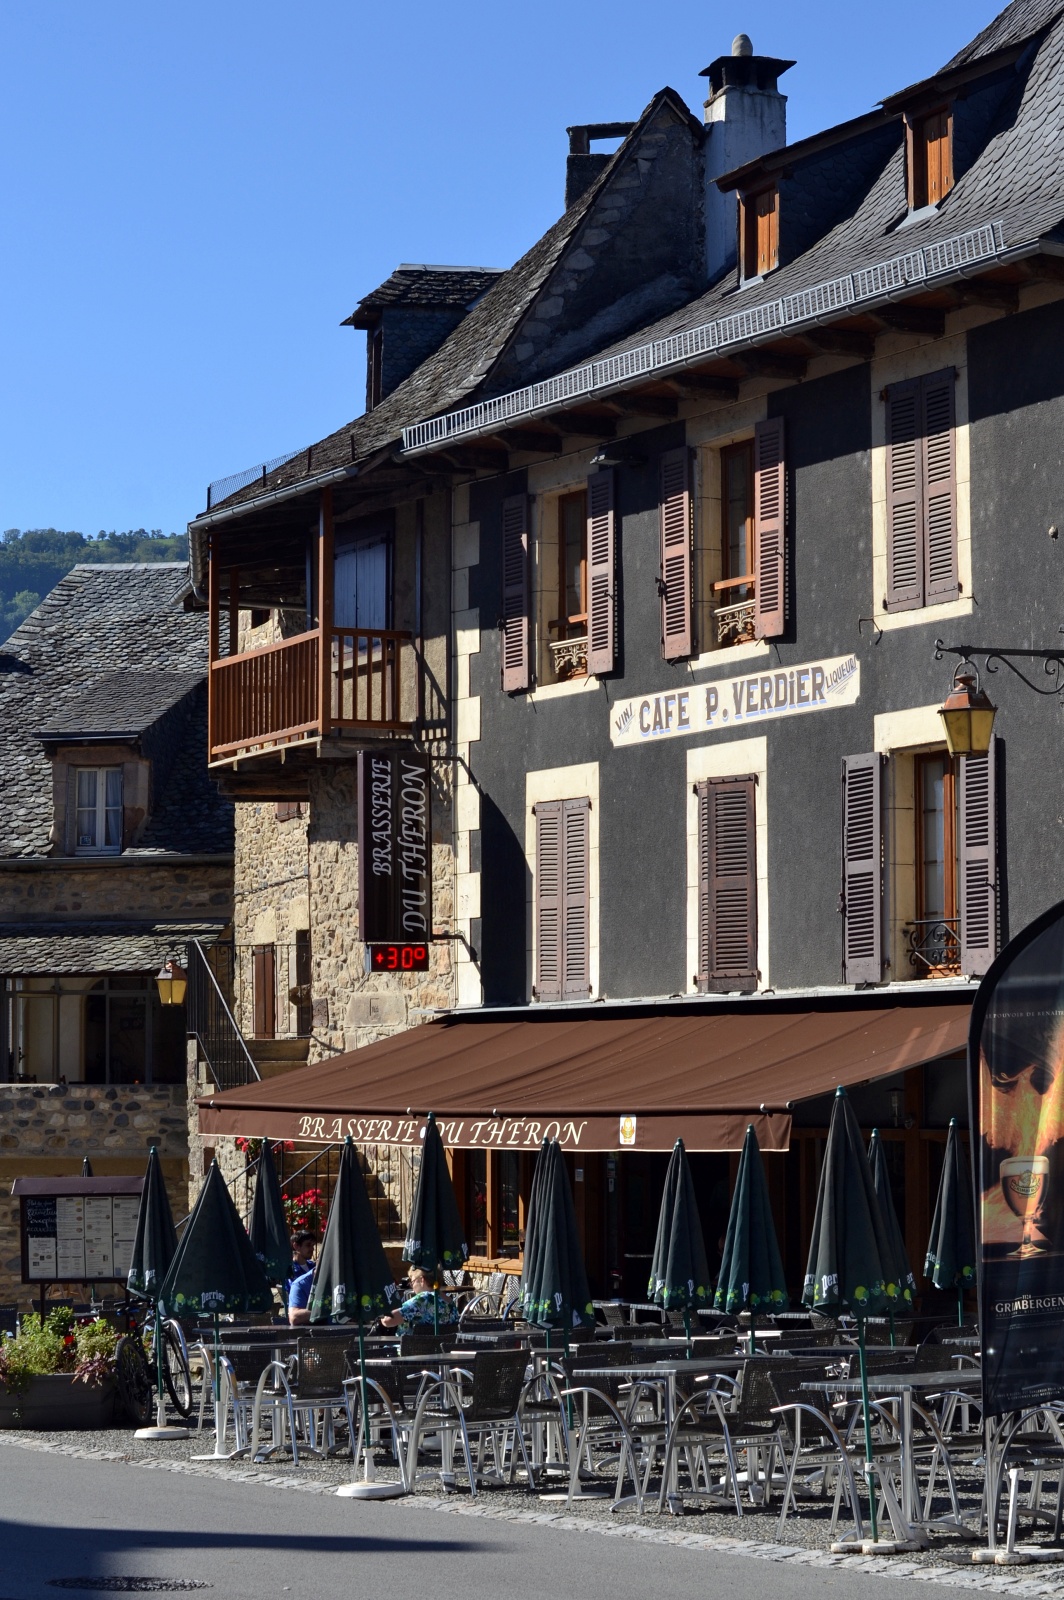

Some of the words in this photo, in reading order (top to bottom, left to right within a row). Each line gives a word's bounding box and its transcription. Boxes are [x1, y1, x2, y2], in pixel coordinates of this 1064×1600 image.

[825, 654, 857, 689] LIQUEURS
[615, 702, 634, 731] VINS
[639, 692, 690, 737] CAFE
[372, 758, 391, 876] BRASSERIE
[397, 759, 426, 881] THERON
[402, 888, 427, 933] DU
[299, 1116, 418, 1142] BRASSERIE
[470, 1117, 587, 1145] THÉRON
[995, 1297, 1064, 1313] GRIMBERGEN
